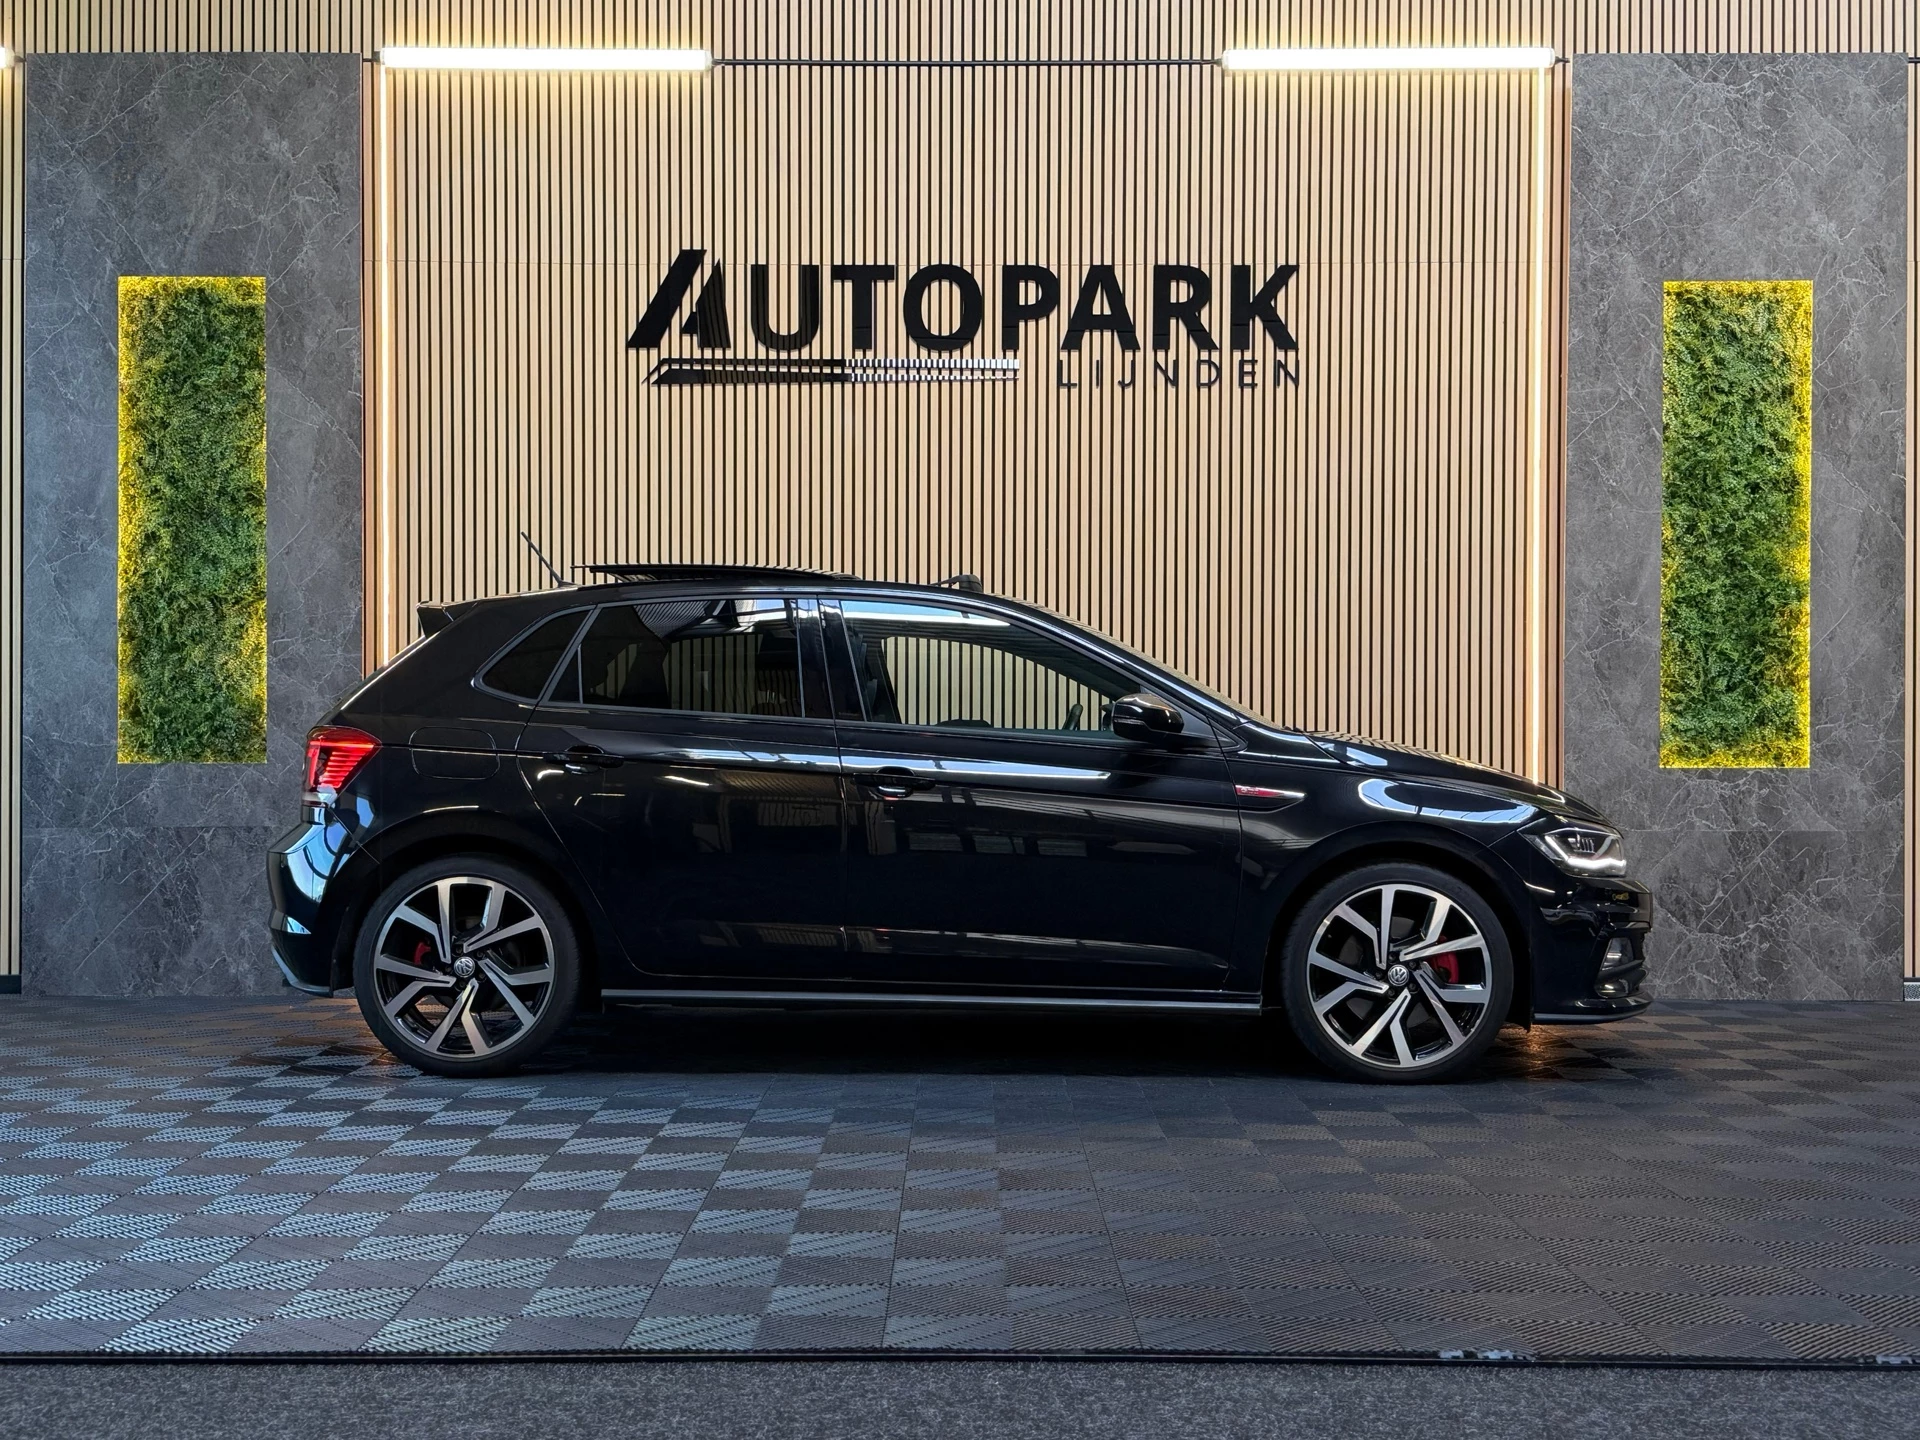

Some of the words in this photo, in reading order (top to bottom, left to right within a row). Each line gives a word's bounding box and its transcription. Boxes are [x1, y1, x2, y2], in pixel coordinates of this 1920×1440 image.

[627, 249, 1299, 351] AUTOPARK
[1057, 359, 1300, 389] LIJNDEN
[1389, 965, 1409, 986] VW
